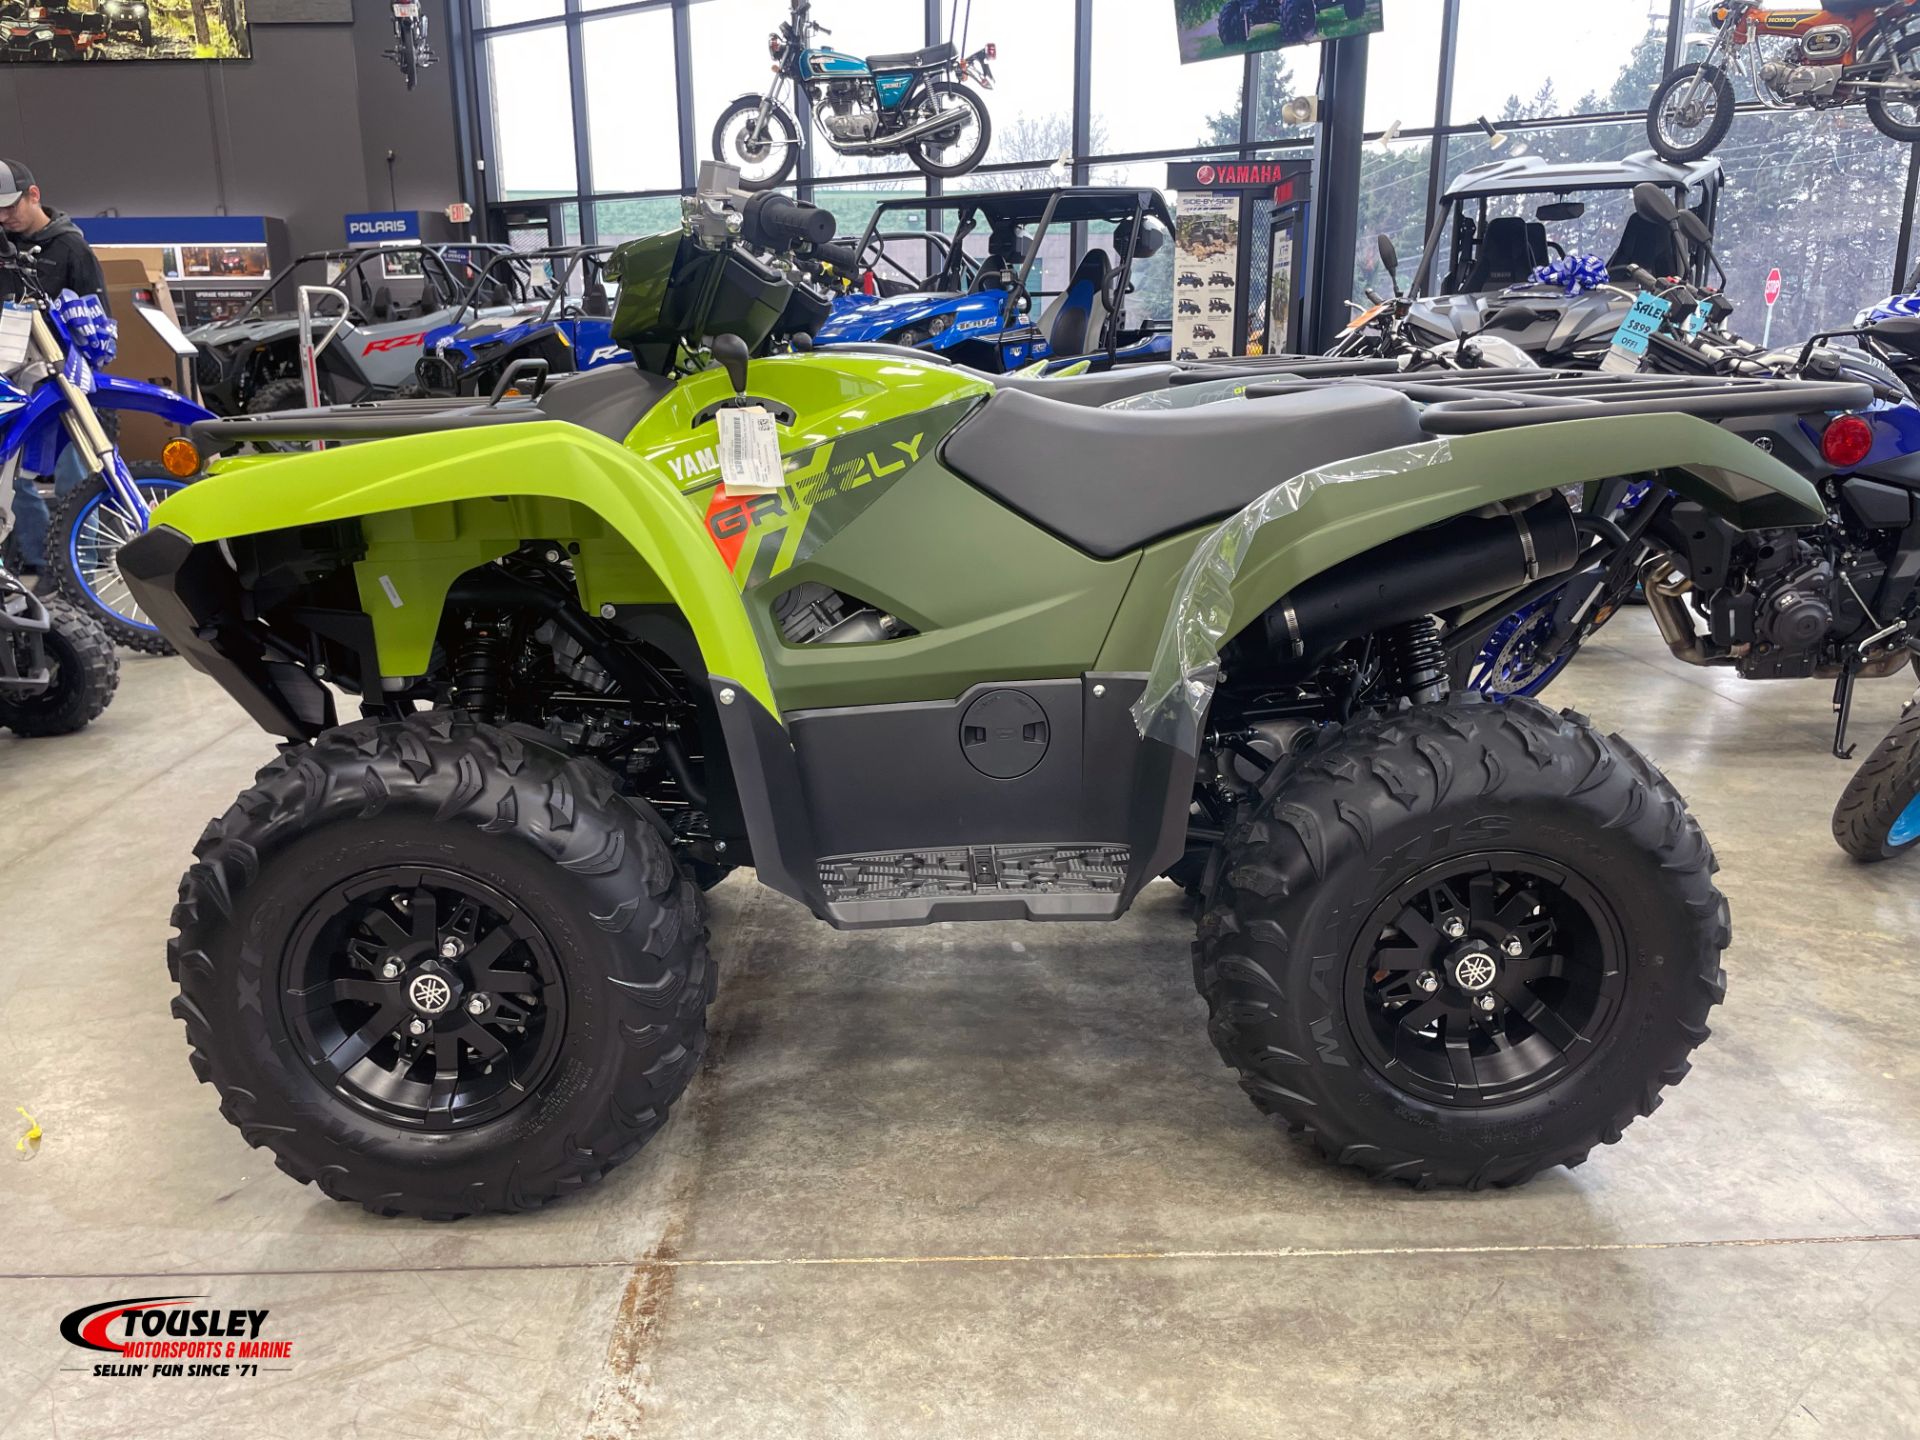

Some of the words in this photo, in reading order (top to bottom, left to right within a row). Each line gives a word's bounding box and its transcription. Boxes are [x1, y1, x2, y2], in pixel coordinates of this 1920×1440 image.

[1216, 164, 1282, 184] YAMAHA
[350, 220, 406, 234] POLARIS
[1766, 279, 1780, 294] STOP
[1634, 301, 1665, 321] SALE!
[1627, 320, 1651, 334] $899
[1621, 338, 1639, 349] OFF!
[666, 446, 719, 481] YAM
[710, 432, 924, 540] GRIZZLY
